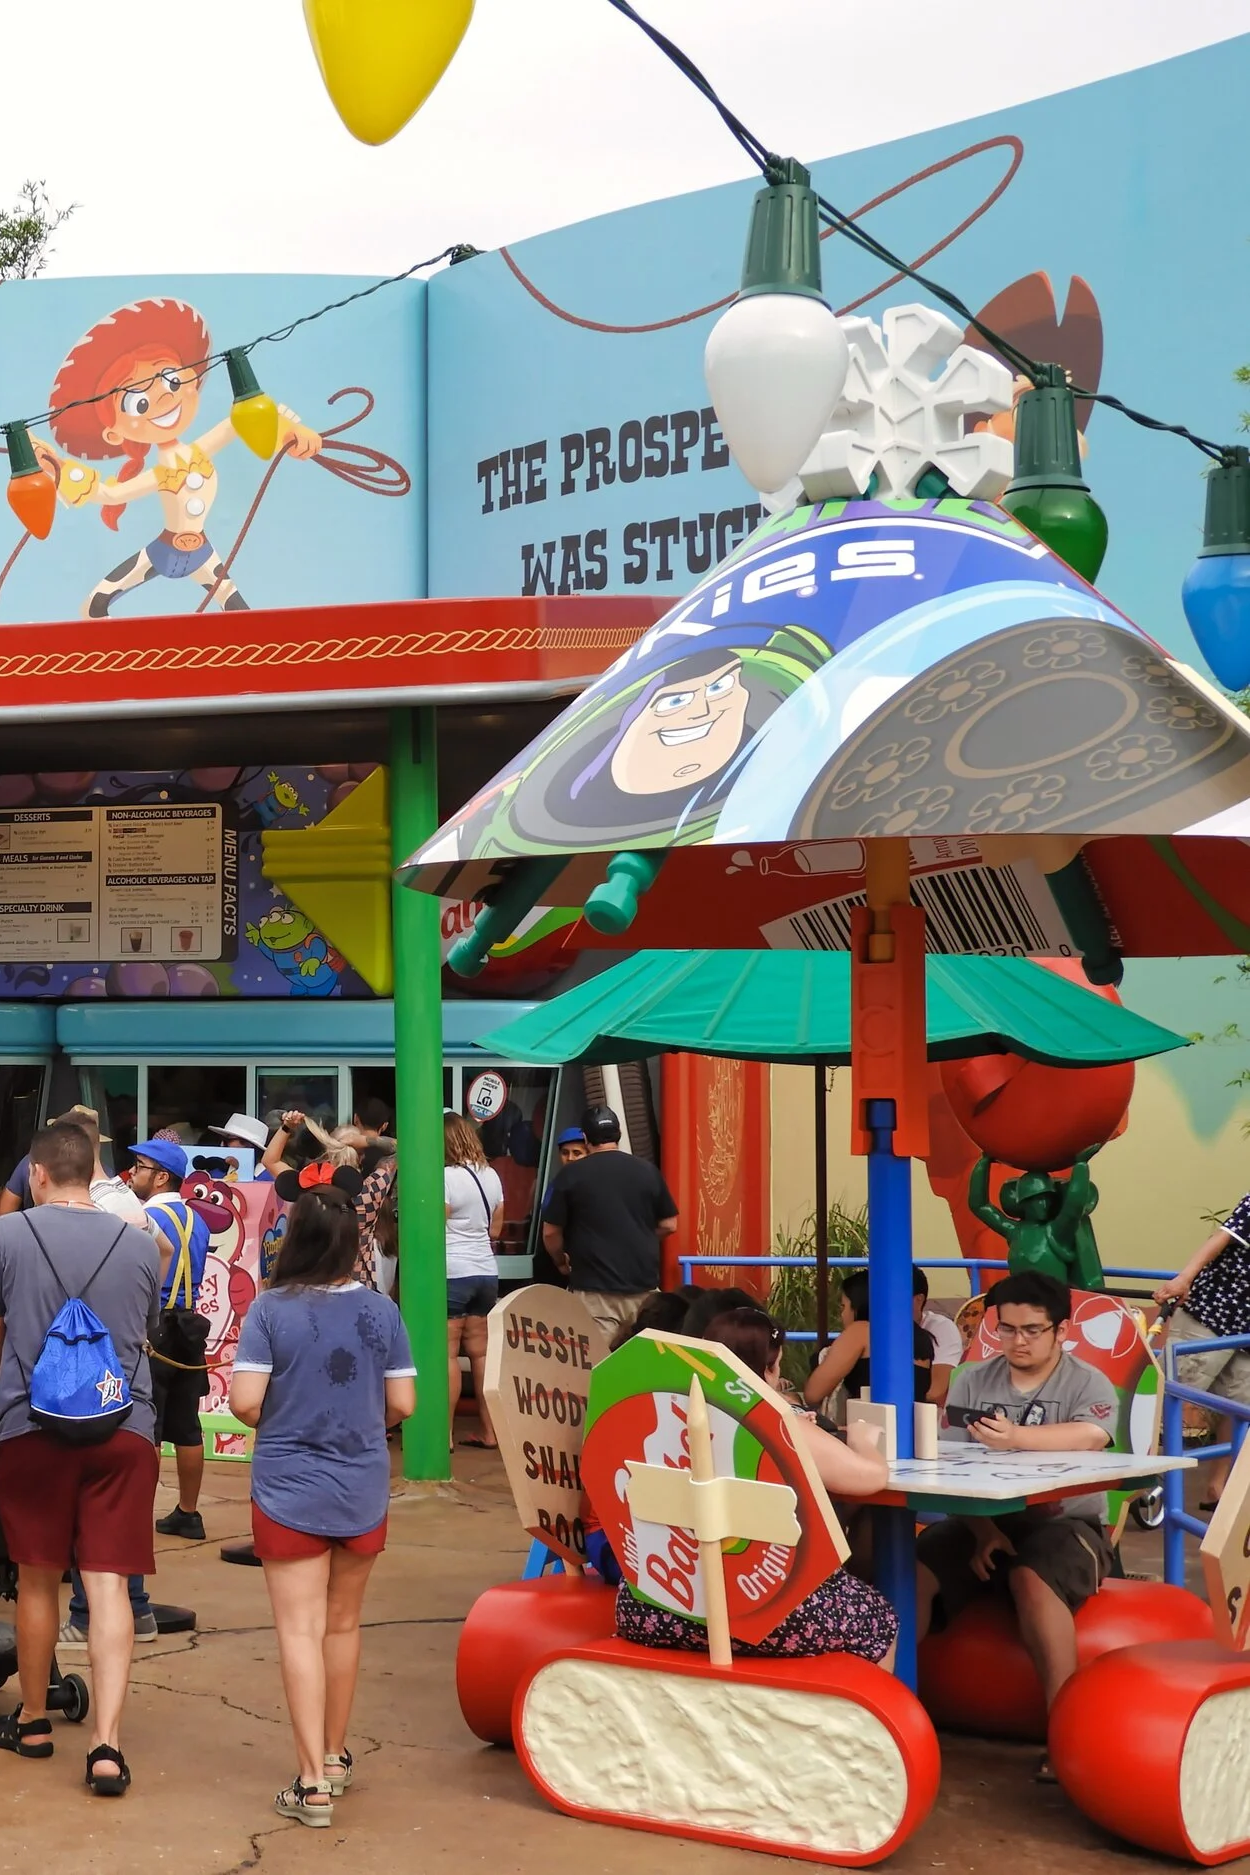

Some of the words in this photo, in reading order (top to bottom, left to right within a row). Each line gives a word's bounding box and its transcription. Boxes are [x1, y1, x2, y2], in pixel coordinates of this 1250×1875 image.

[477, 439, 547, 515] THE
[560, 406, 730, 497] PROSPE
[520, 528, 608, 596] WAS
[13, 813, 51, 822] DESSERTS
[111, 810, 170, 819] NON-ALCOHOLIC
[172, 809, 212, 818] BEVERAGES
[2, 854, 29, 863] MEALS
[107, 877, 147, 885] ALCOHOLIC
[148, 875, 187, 884] BEVERAGES
[187, 875, 200, 883] ON
[200, 874, 214, 882] TAP
[224, 828, 237, 880] MENU
[0, 904, 39, 913] SPECIALTY
[39, 903, 65, 912] DRINK
[223, 883, 237, 936] FACTS
[513, 1375, 588, 1427] WOOD
[618, 1522, 639, 1574] Mini
